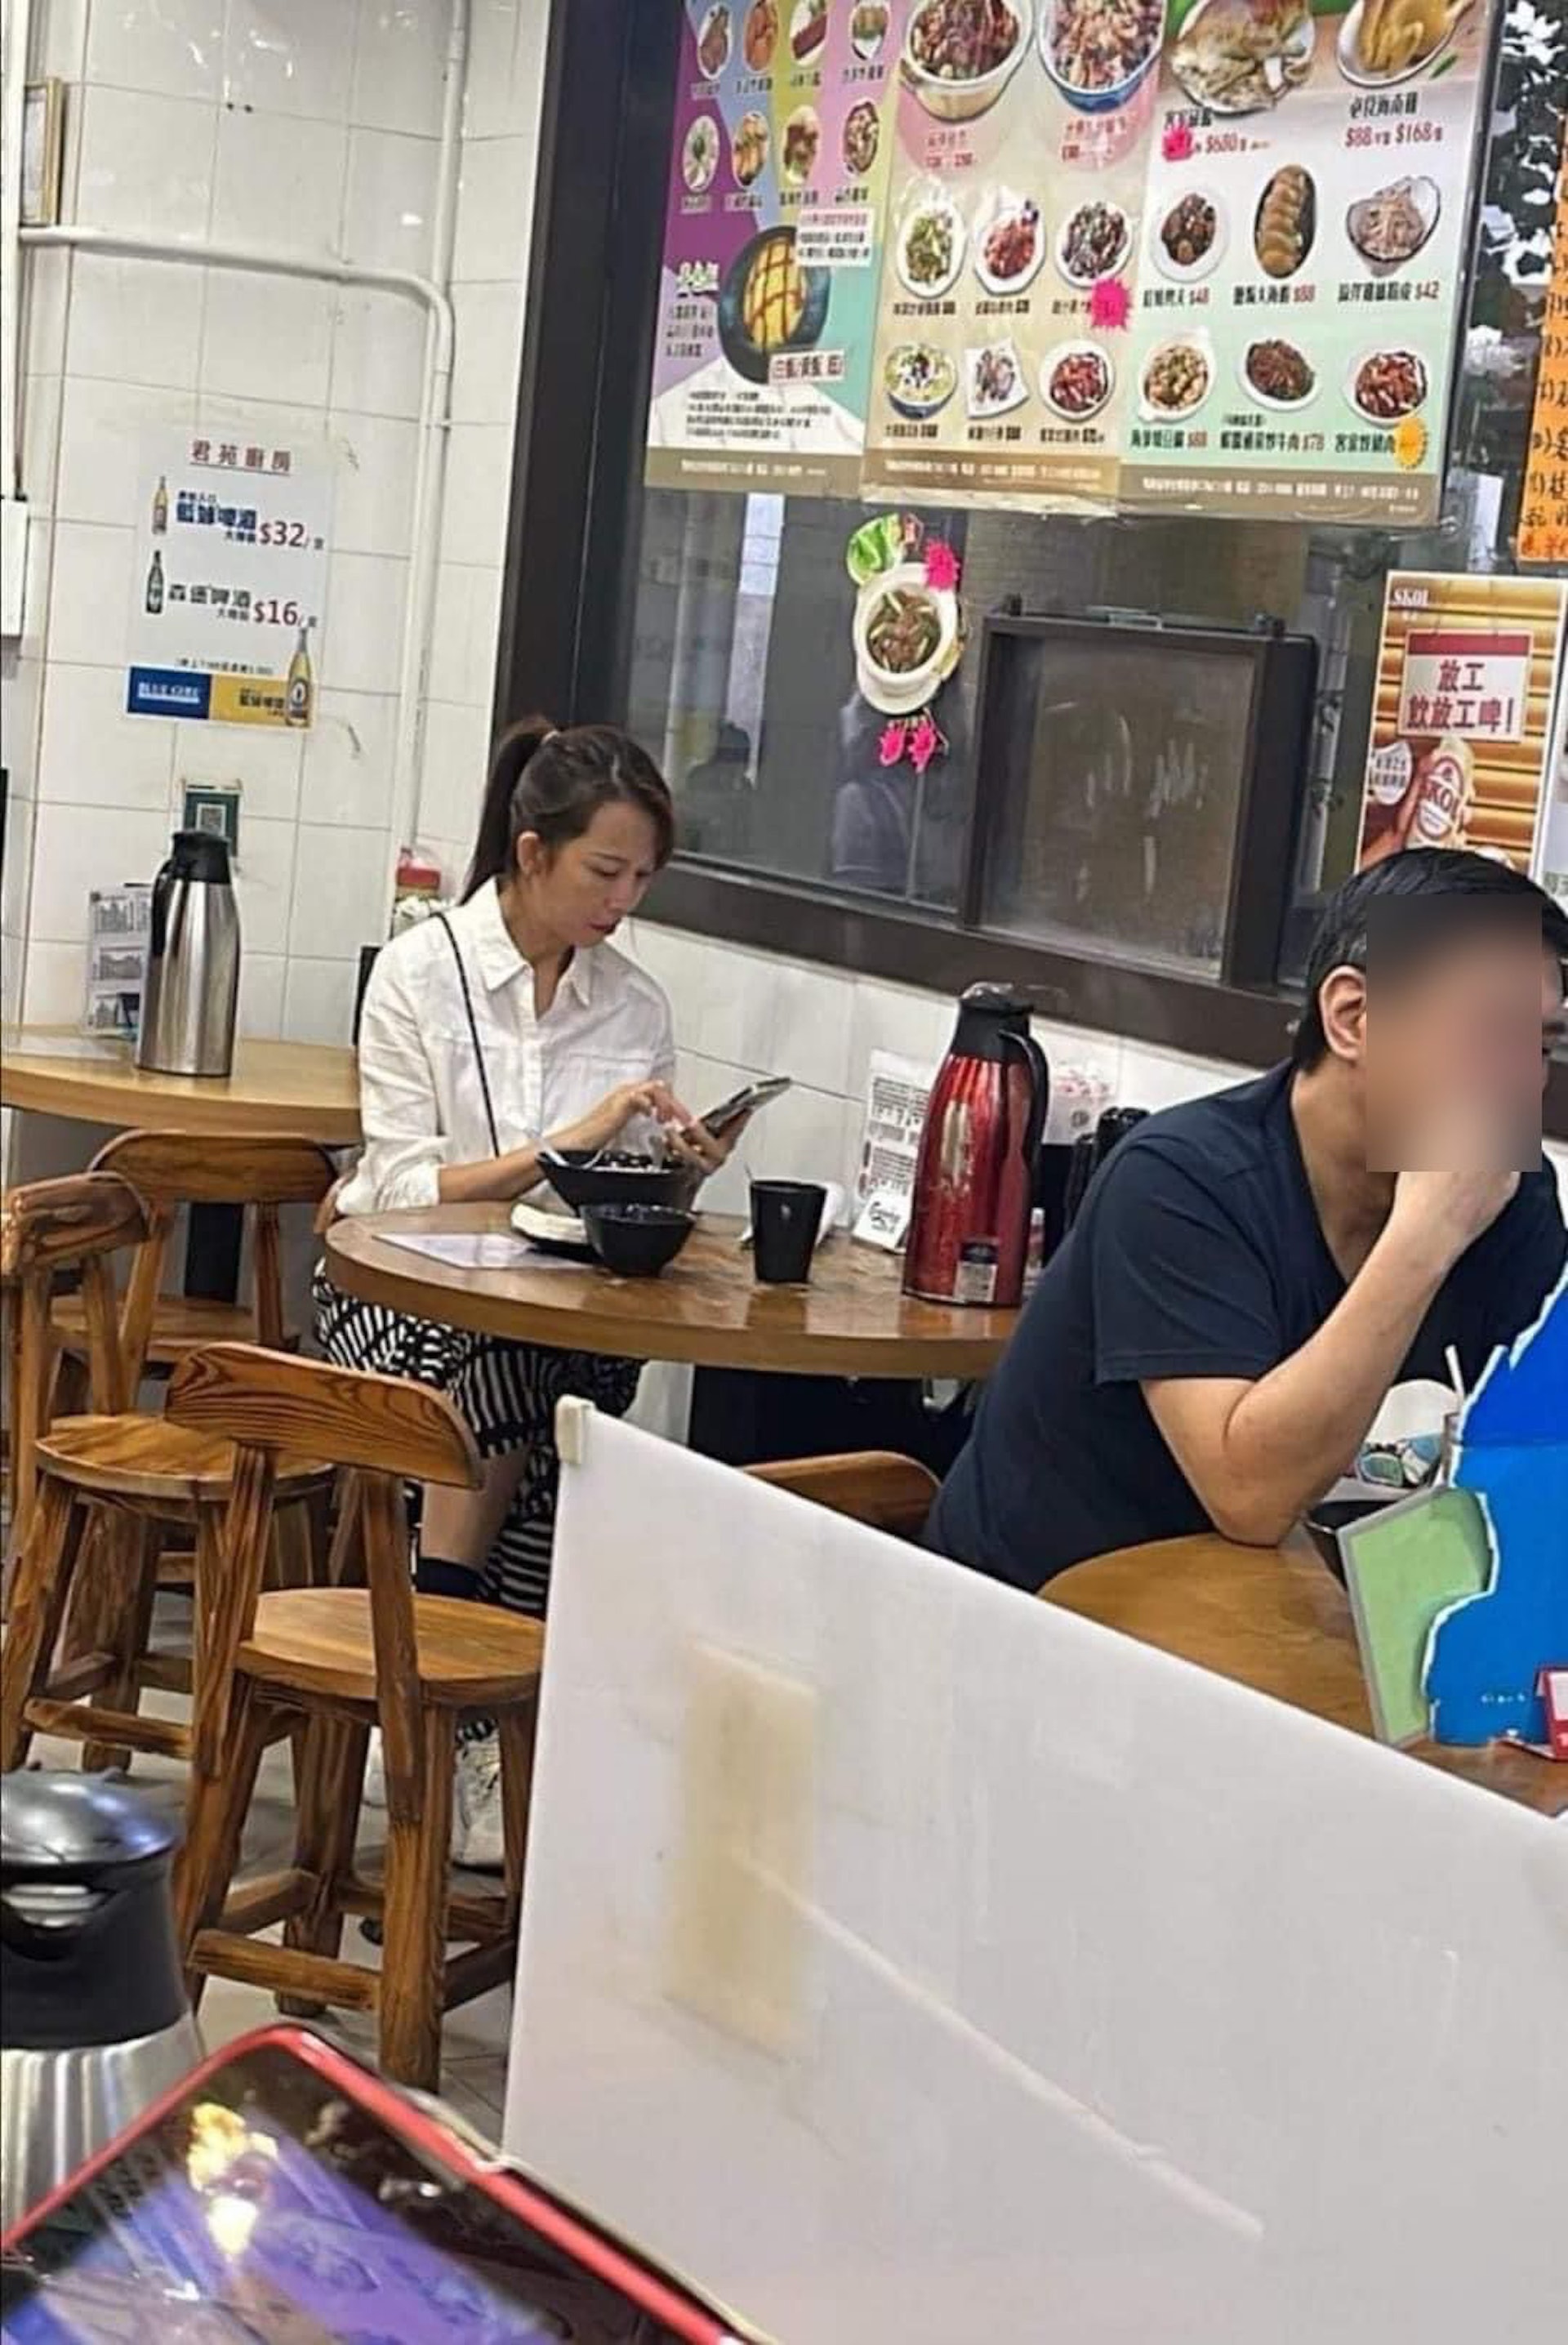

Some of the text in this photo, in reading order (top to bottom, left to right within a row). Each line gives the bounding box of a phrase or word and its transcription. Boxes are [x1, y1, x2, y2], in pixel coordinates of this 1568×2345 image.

[1415, 281, 1439, 301] $42
[192, 439, 291, 472] 君苑廚房
[1392, 588, 1429, 605] SKOL
[1437, 659, 1485, 693] 放工
